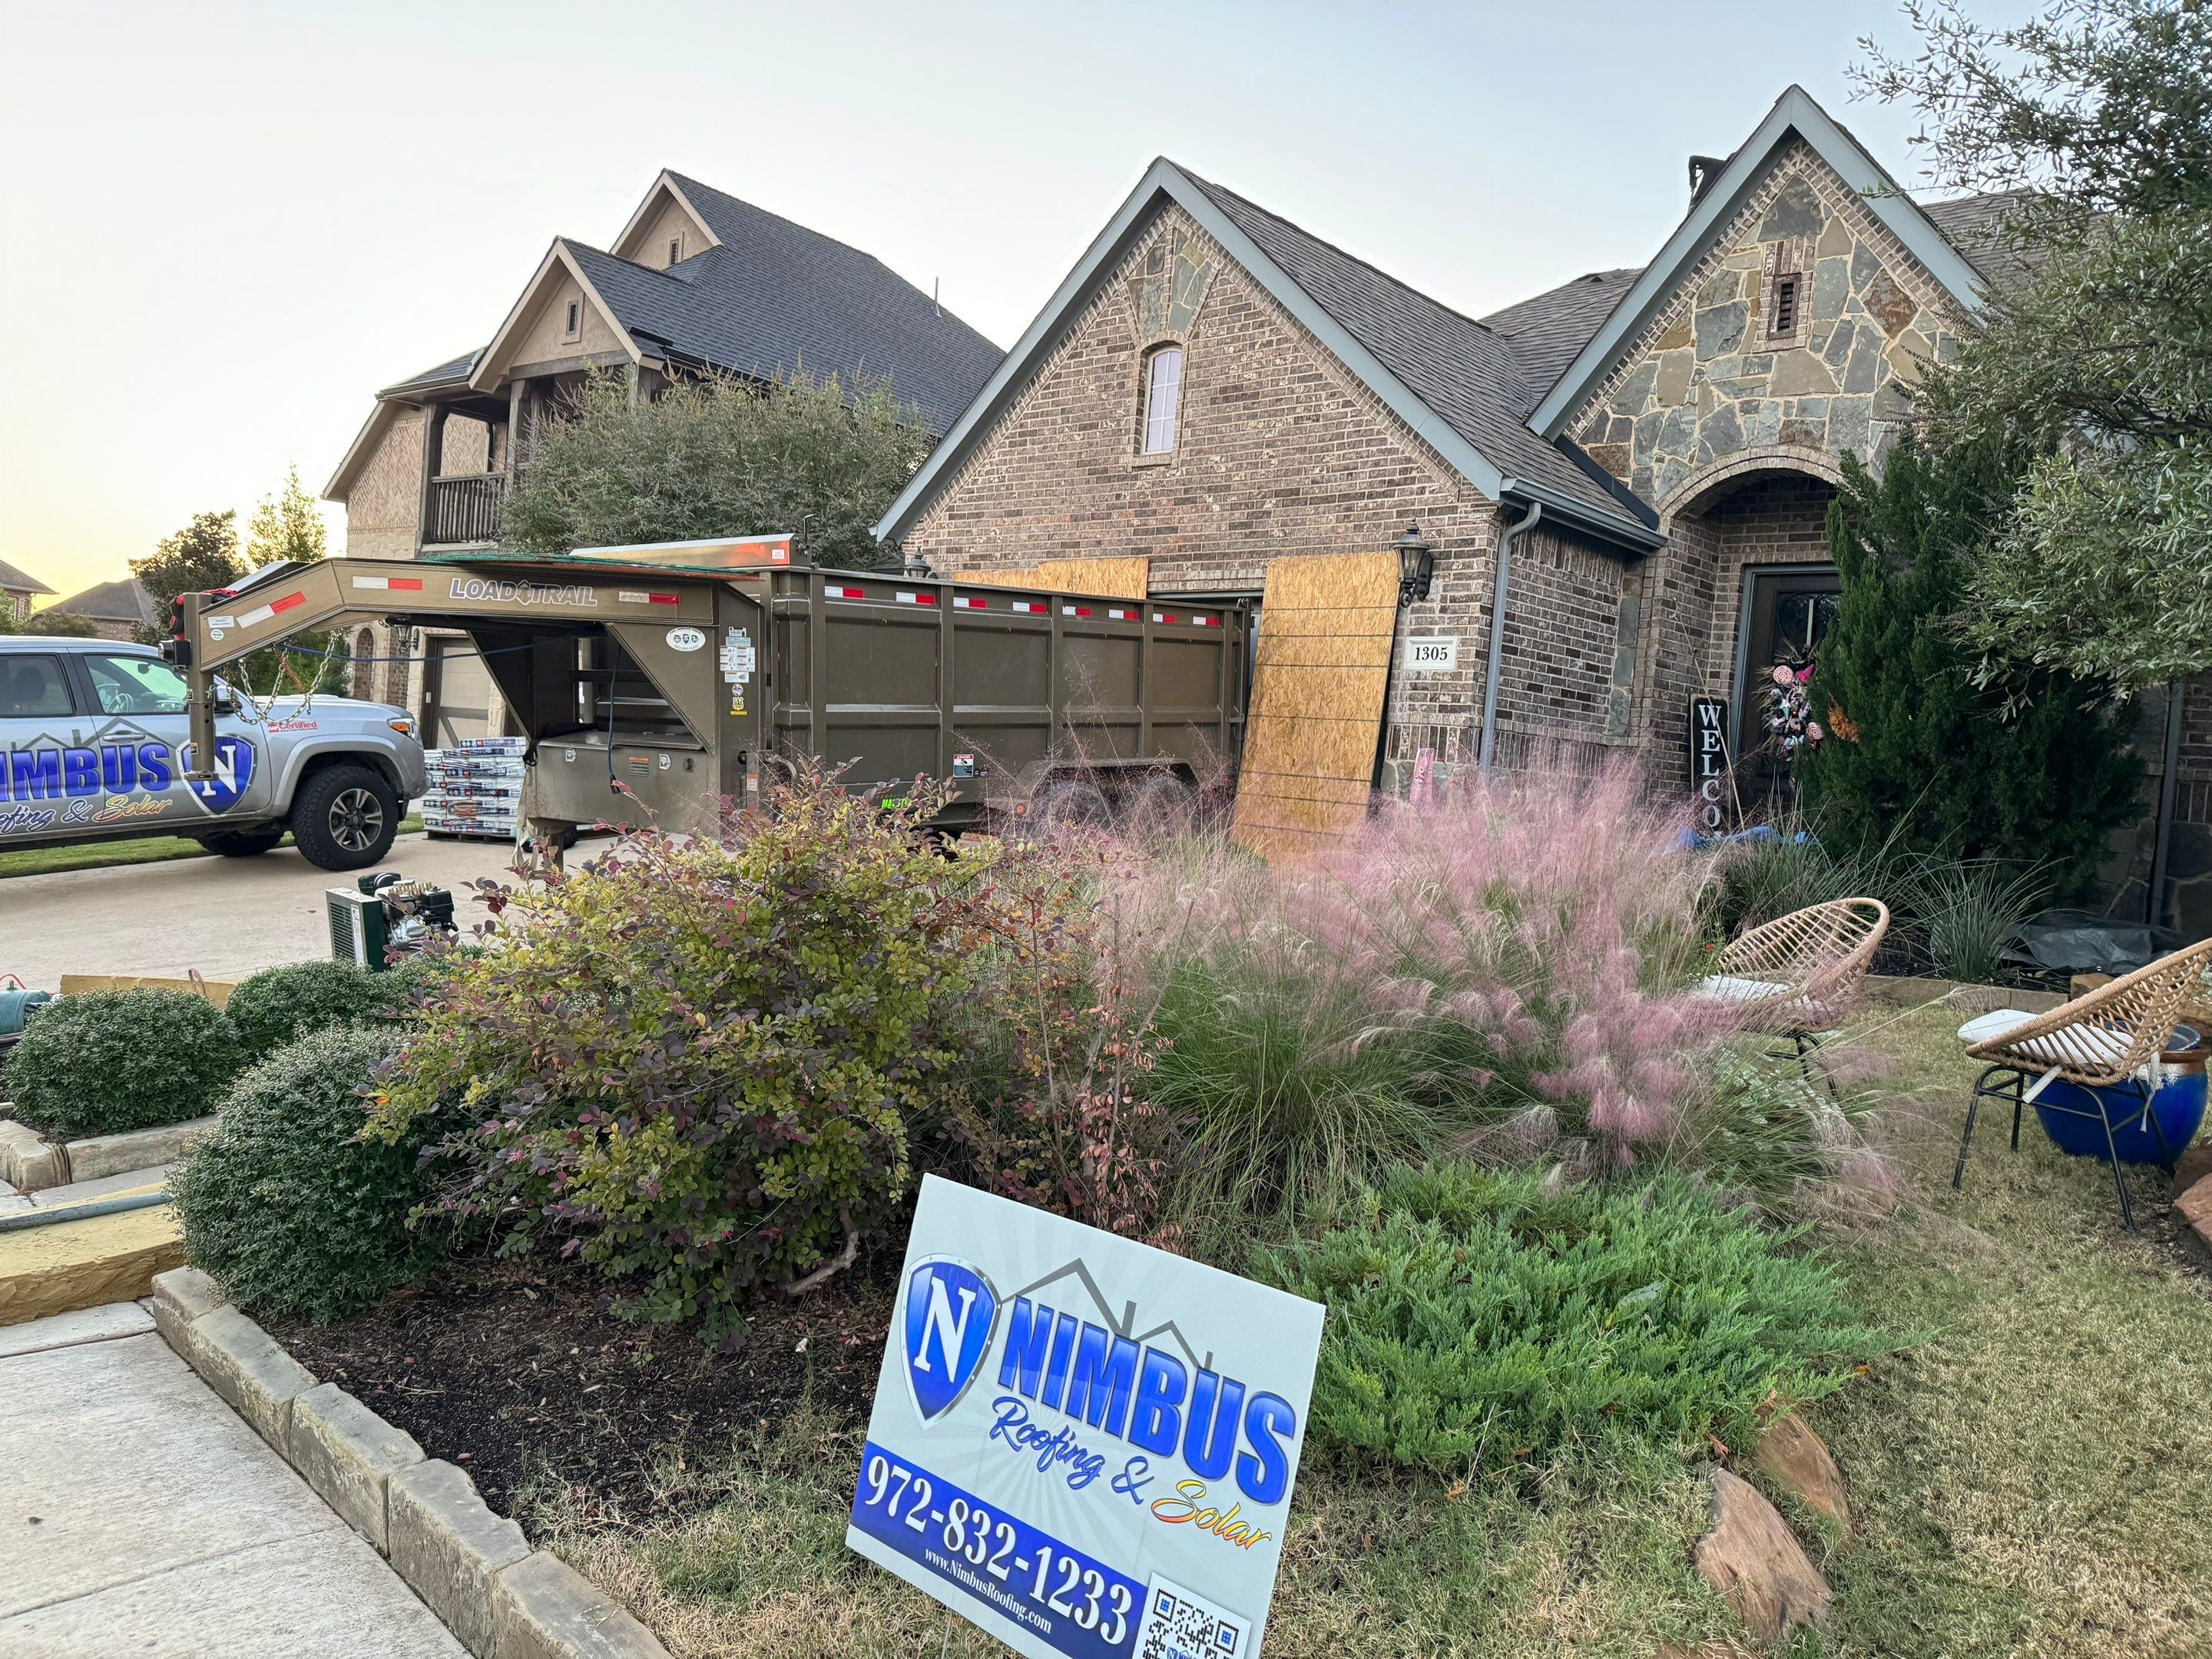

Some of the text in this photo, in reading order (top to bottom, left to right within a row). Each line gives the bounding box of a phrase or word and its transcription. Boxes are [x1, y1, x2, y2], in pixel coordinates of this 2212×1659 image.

[449, 578, 598, 607] LOAD TRAIL
[1415, 646, 1448, 661] 1305
[279, 720, 317, 730] Certified
[1698, 704, 1723, 839] WELCO
[61, 799, 93, 823] &
[92, 794, 173, 823] Solar
[913, 1275, 976, 1384] N
[998, 1294, 1296, 1506] NIMBUS
[988, 1396, 1273, 1551] Roofing & Solar
[865, 1455, 1132, 1645] 972-832-1233
[925, 1548, 1052, 1634] www.NimbusRoofing.com
